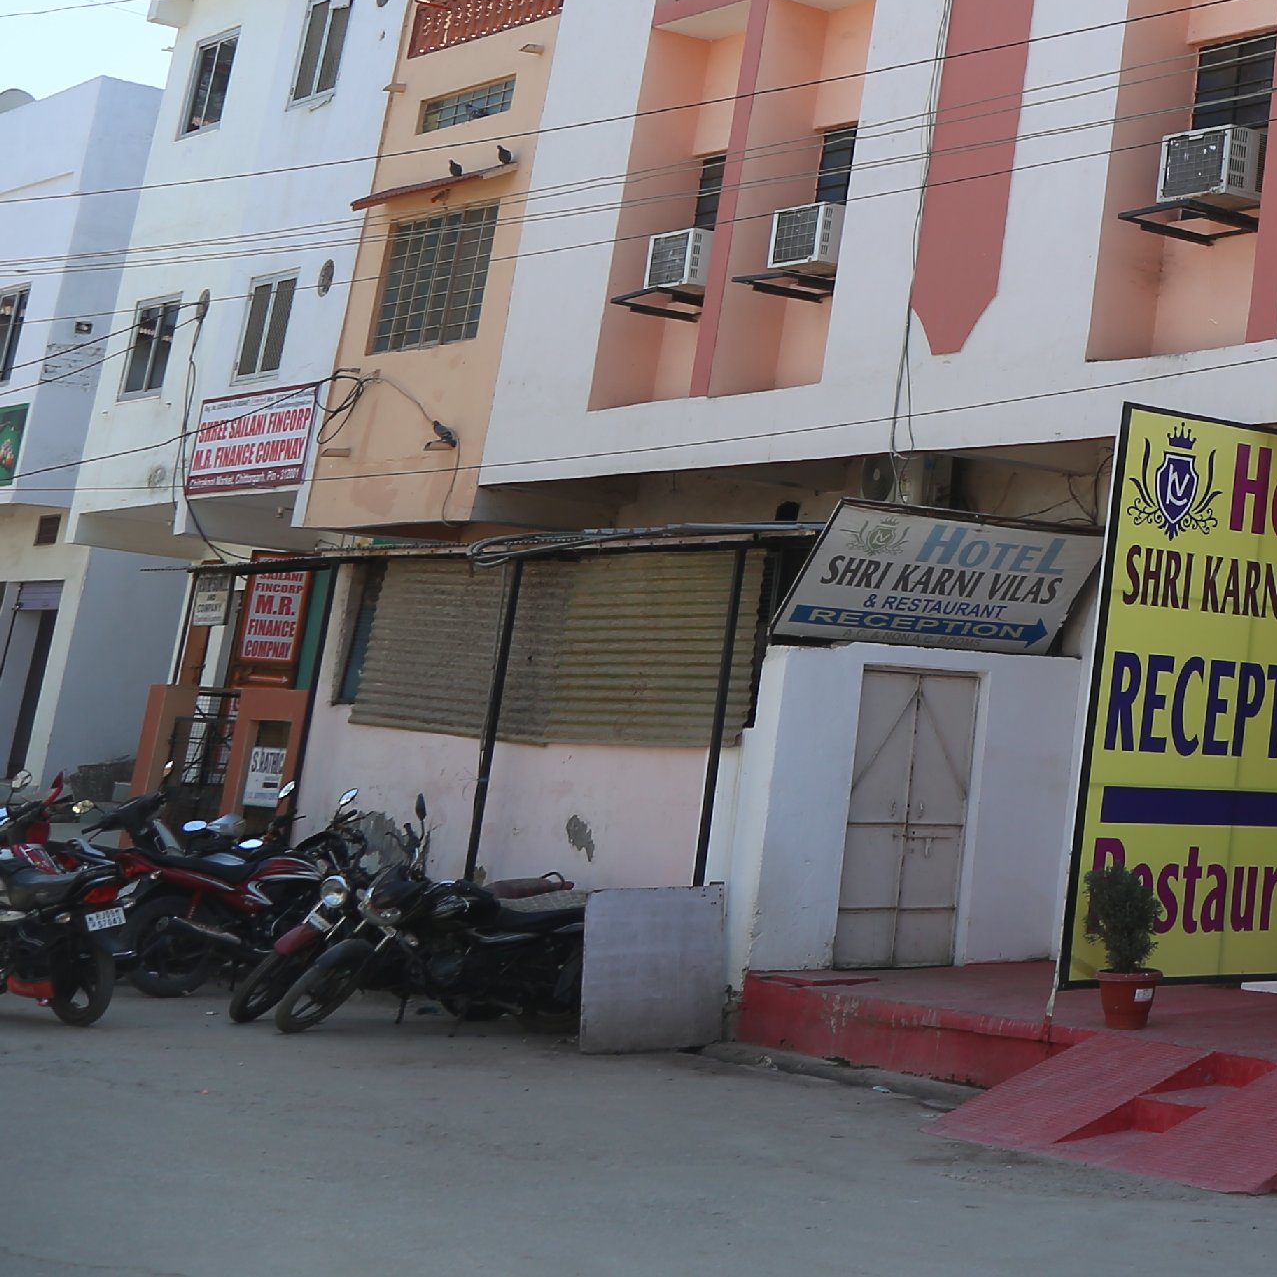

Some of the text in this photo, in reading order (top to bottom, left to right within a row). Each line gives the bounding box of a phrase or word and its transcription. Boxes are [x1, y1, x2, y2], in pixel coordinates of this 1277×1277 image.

[199, 408, 311, 443] SHREE SAILANI FINCORP
[192, 437, 306, 471] M.R. FINANCE COMPNAY
[915, 524, 1066, 574] HOTEL
[255, 583, 303, 594] FINCORP
[820, 555, 1062, 605] SHRI KARNI VILAS
[1122, 544, 1194, 610] SHRI
[255, 594, 295, 615] M.R.
[863, 593, 1007, 620] & RESTAURANT
[248, 619, 296, 637] FINANCE
[808, 609, 1026, 639] RECEPTION
